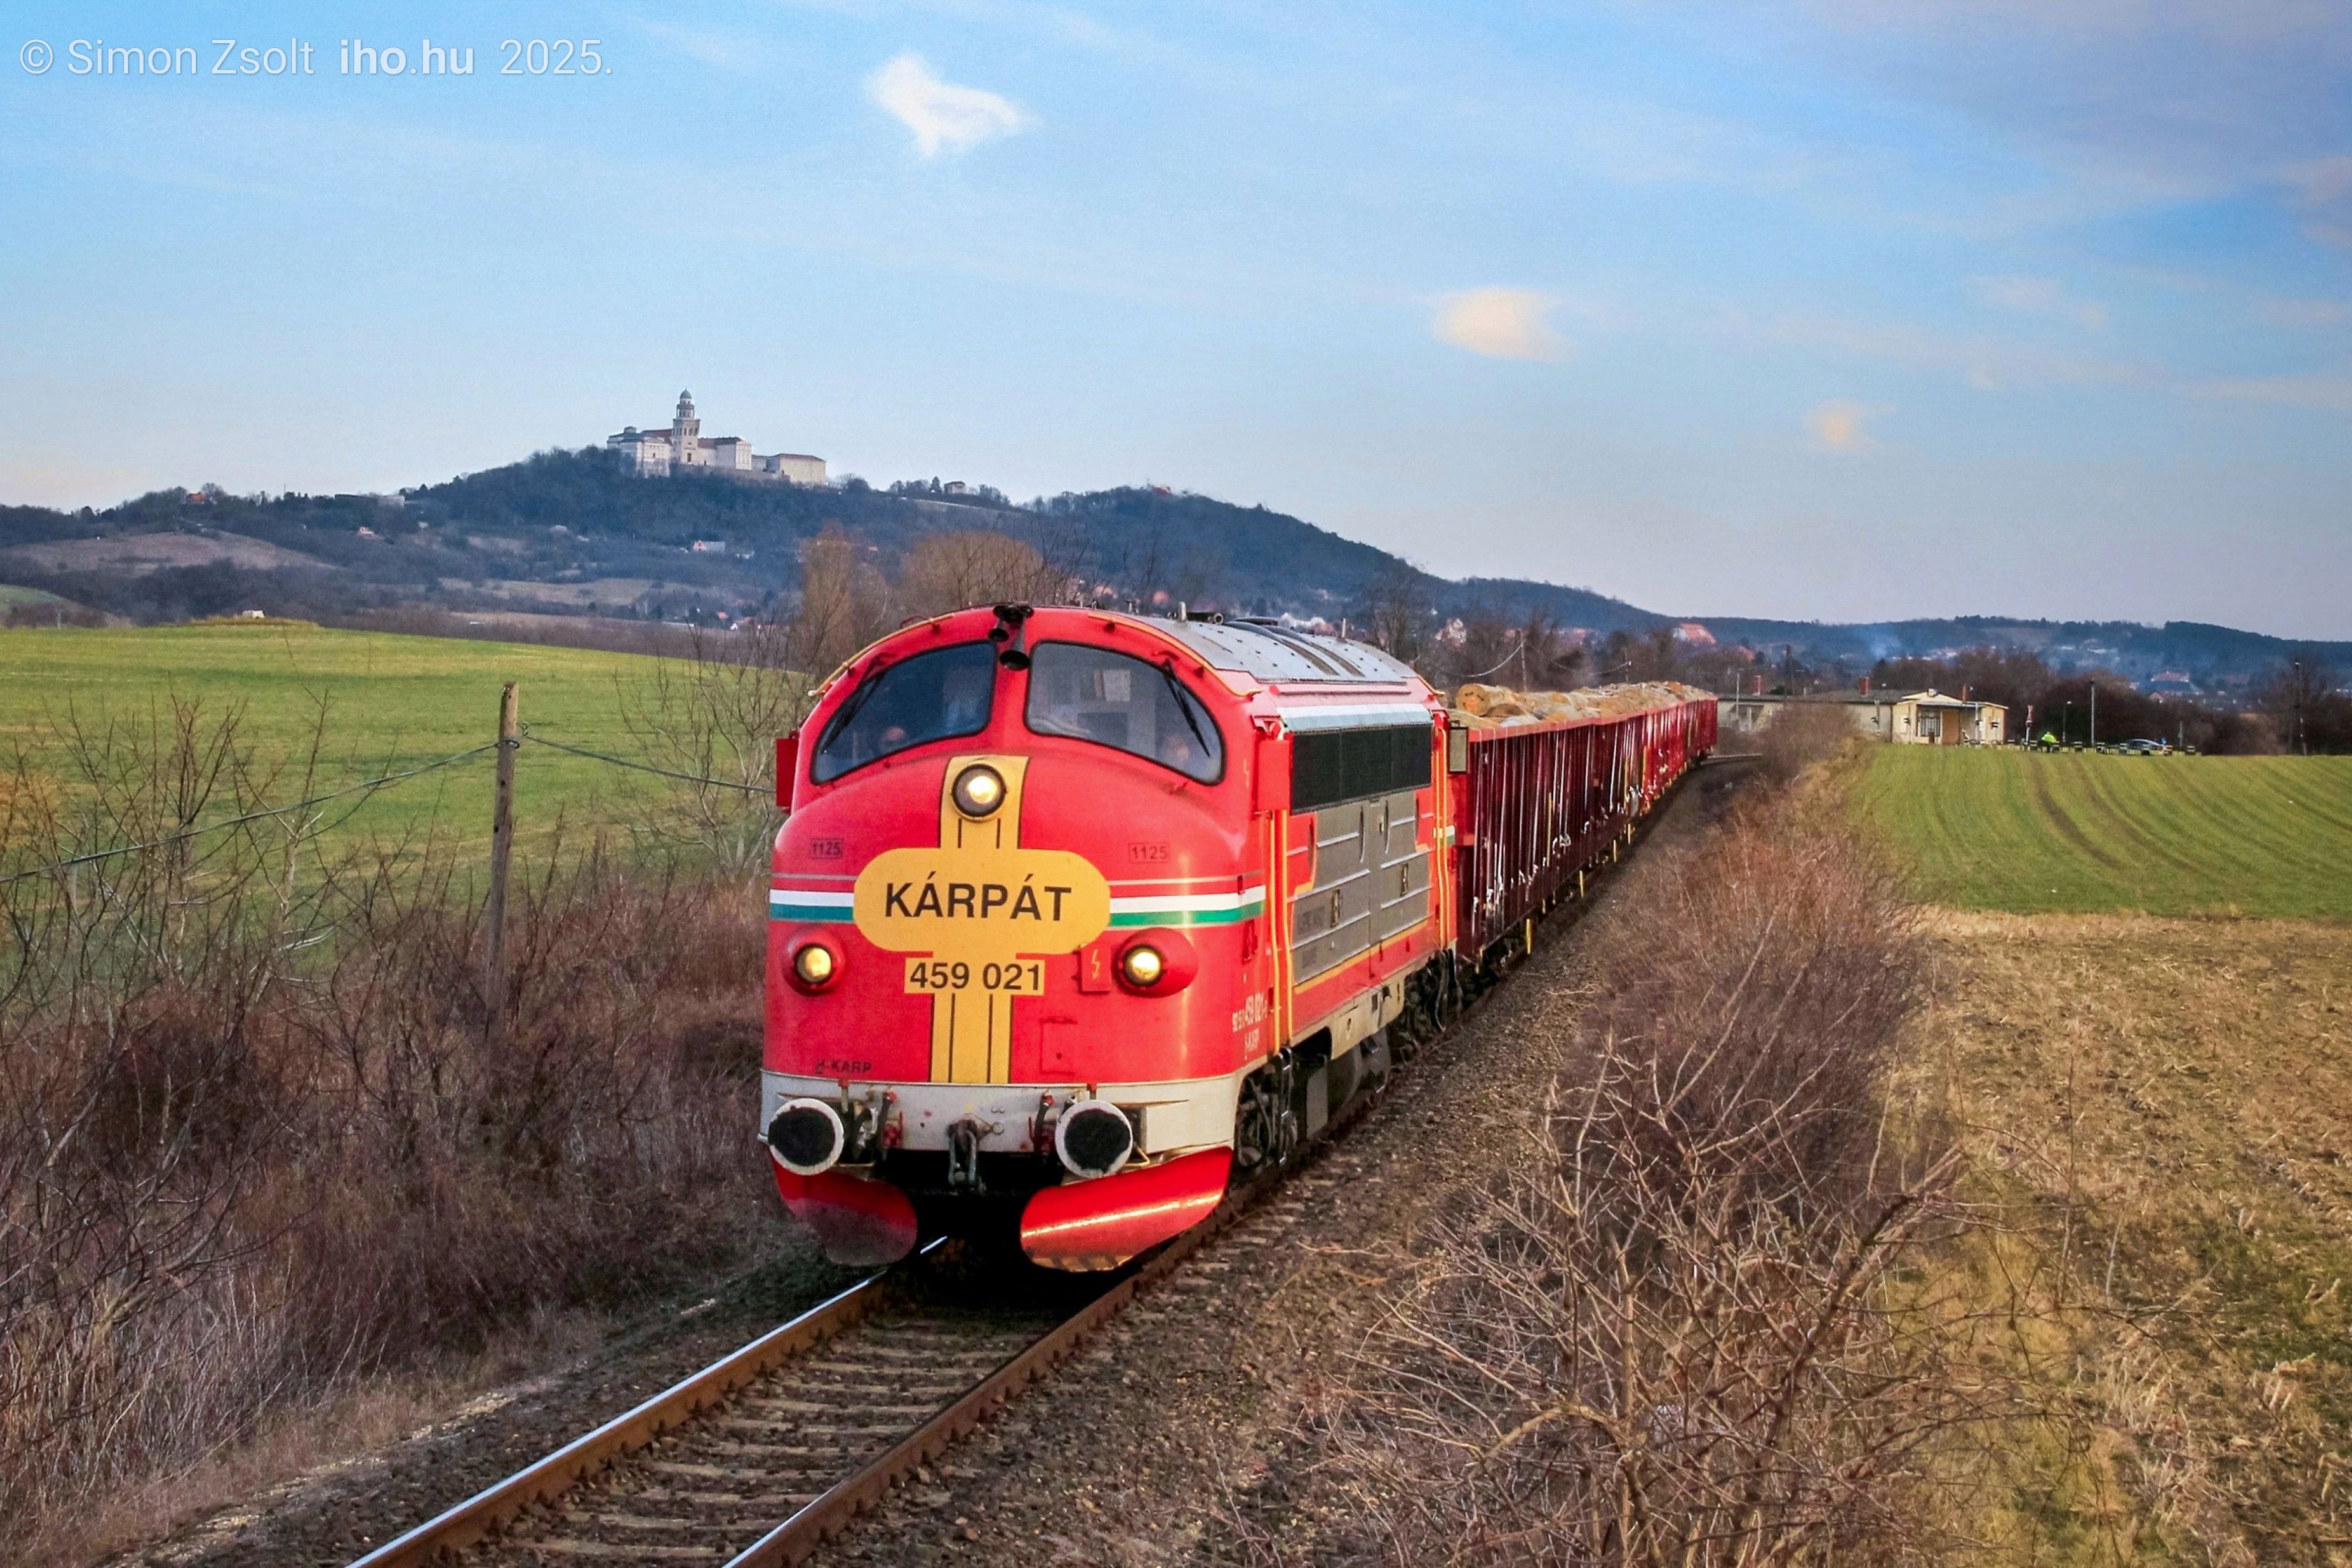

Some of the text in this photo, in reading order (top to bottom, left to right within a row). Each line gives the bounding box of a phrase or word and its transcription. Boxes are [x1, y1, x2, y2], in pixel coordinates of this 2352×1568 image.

[812, 841, 841, 855] 1125
[1132, 845, 1168, 859] 1125
[885, 871, 1072, 921] KÁRPÁT
[910, 962, 1039, 990] 459 021
